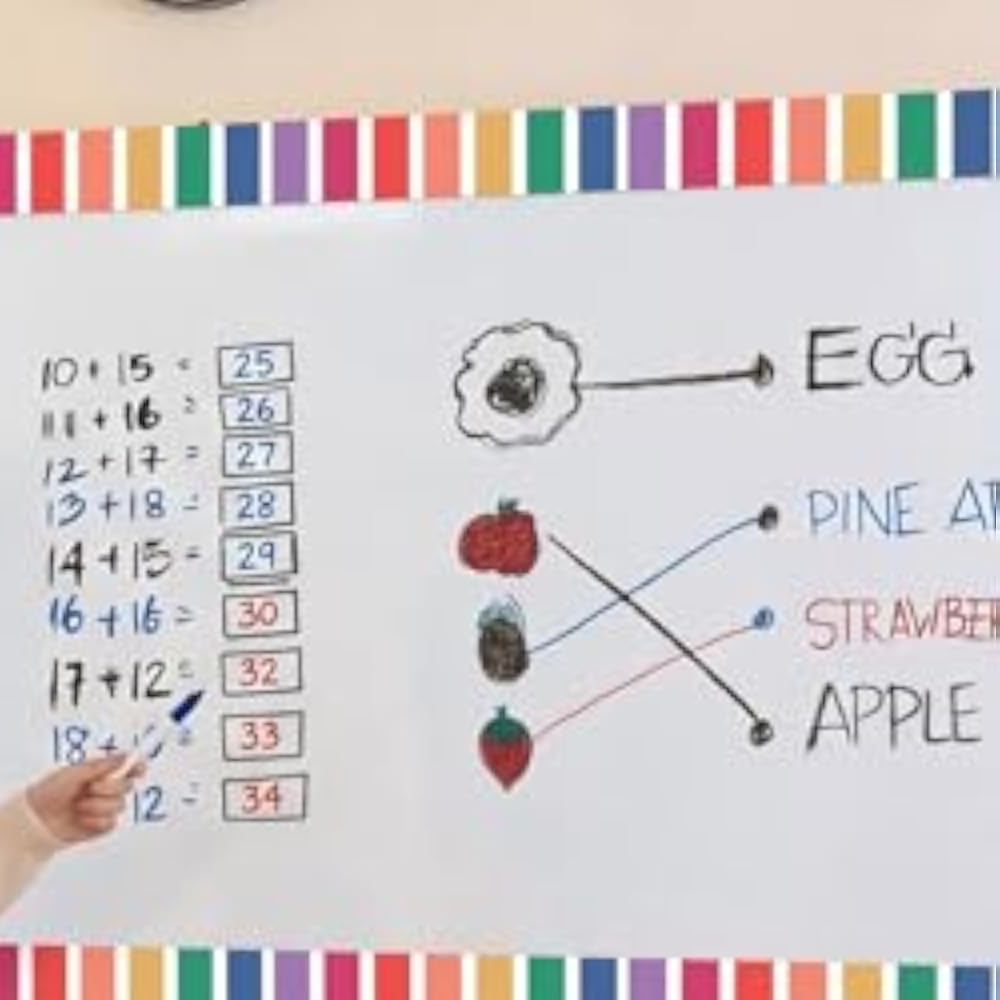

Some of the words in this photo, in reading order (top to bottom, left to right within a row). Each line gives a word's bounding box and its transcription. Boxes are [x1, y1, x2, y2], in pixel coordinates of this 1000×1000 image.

[42, 357, 78, 391] 10
[117, 353, 154, 385] 15
[233, 350, 275, 378] 25
[807, 320, 974, 390] EGG
[42, 410, 75, 439] 11
[124, 394, 161, 432] 16
[237, 395, 275, 423] 26
[42, 458, 88, 486] 12
[126, 445, 167, 476] 17
[236, 441, 276, 469] 27
[46, 492, 87, 527] 13
[129, 489, 166, 521] 18
[236, 491, 275, 519] 28
[807, 482, 926, 536] PINE
[49, 541, 85, 586] 14
[133, 539, 173, 579] 15
[236, 542, 275, 570] 29
[49, 594, 83, 635] 16
[237, 601, 279, 629] 30
[50, 659, 84, 710] 17
[131, 661, 171, 701] 12
[239, 658, 278, 687] 32
[806, 682, 982, 750] APPLE
[53, 725, 89, 763] 18
[240, 722, 280, 750] 33
[133, 785, 166, 825] 12
[241, 786, 280, 814] 34
